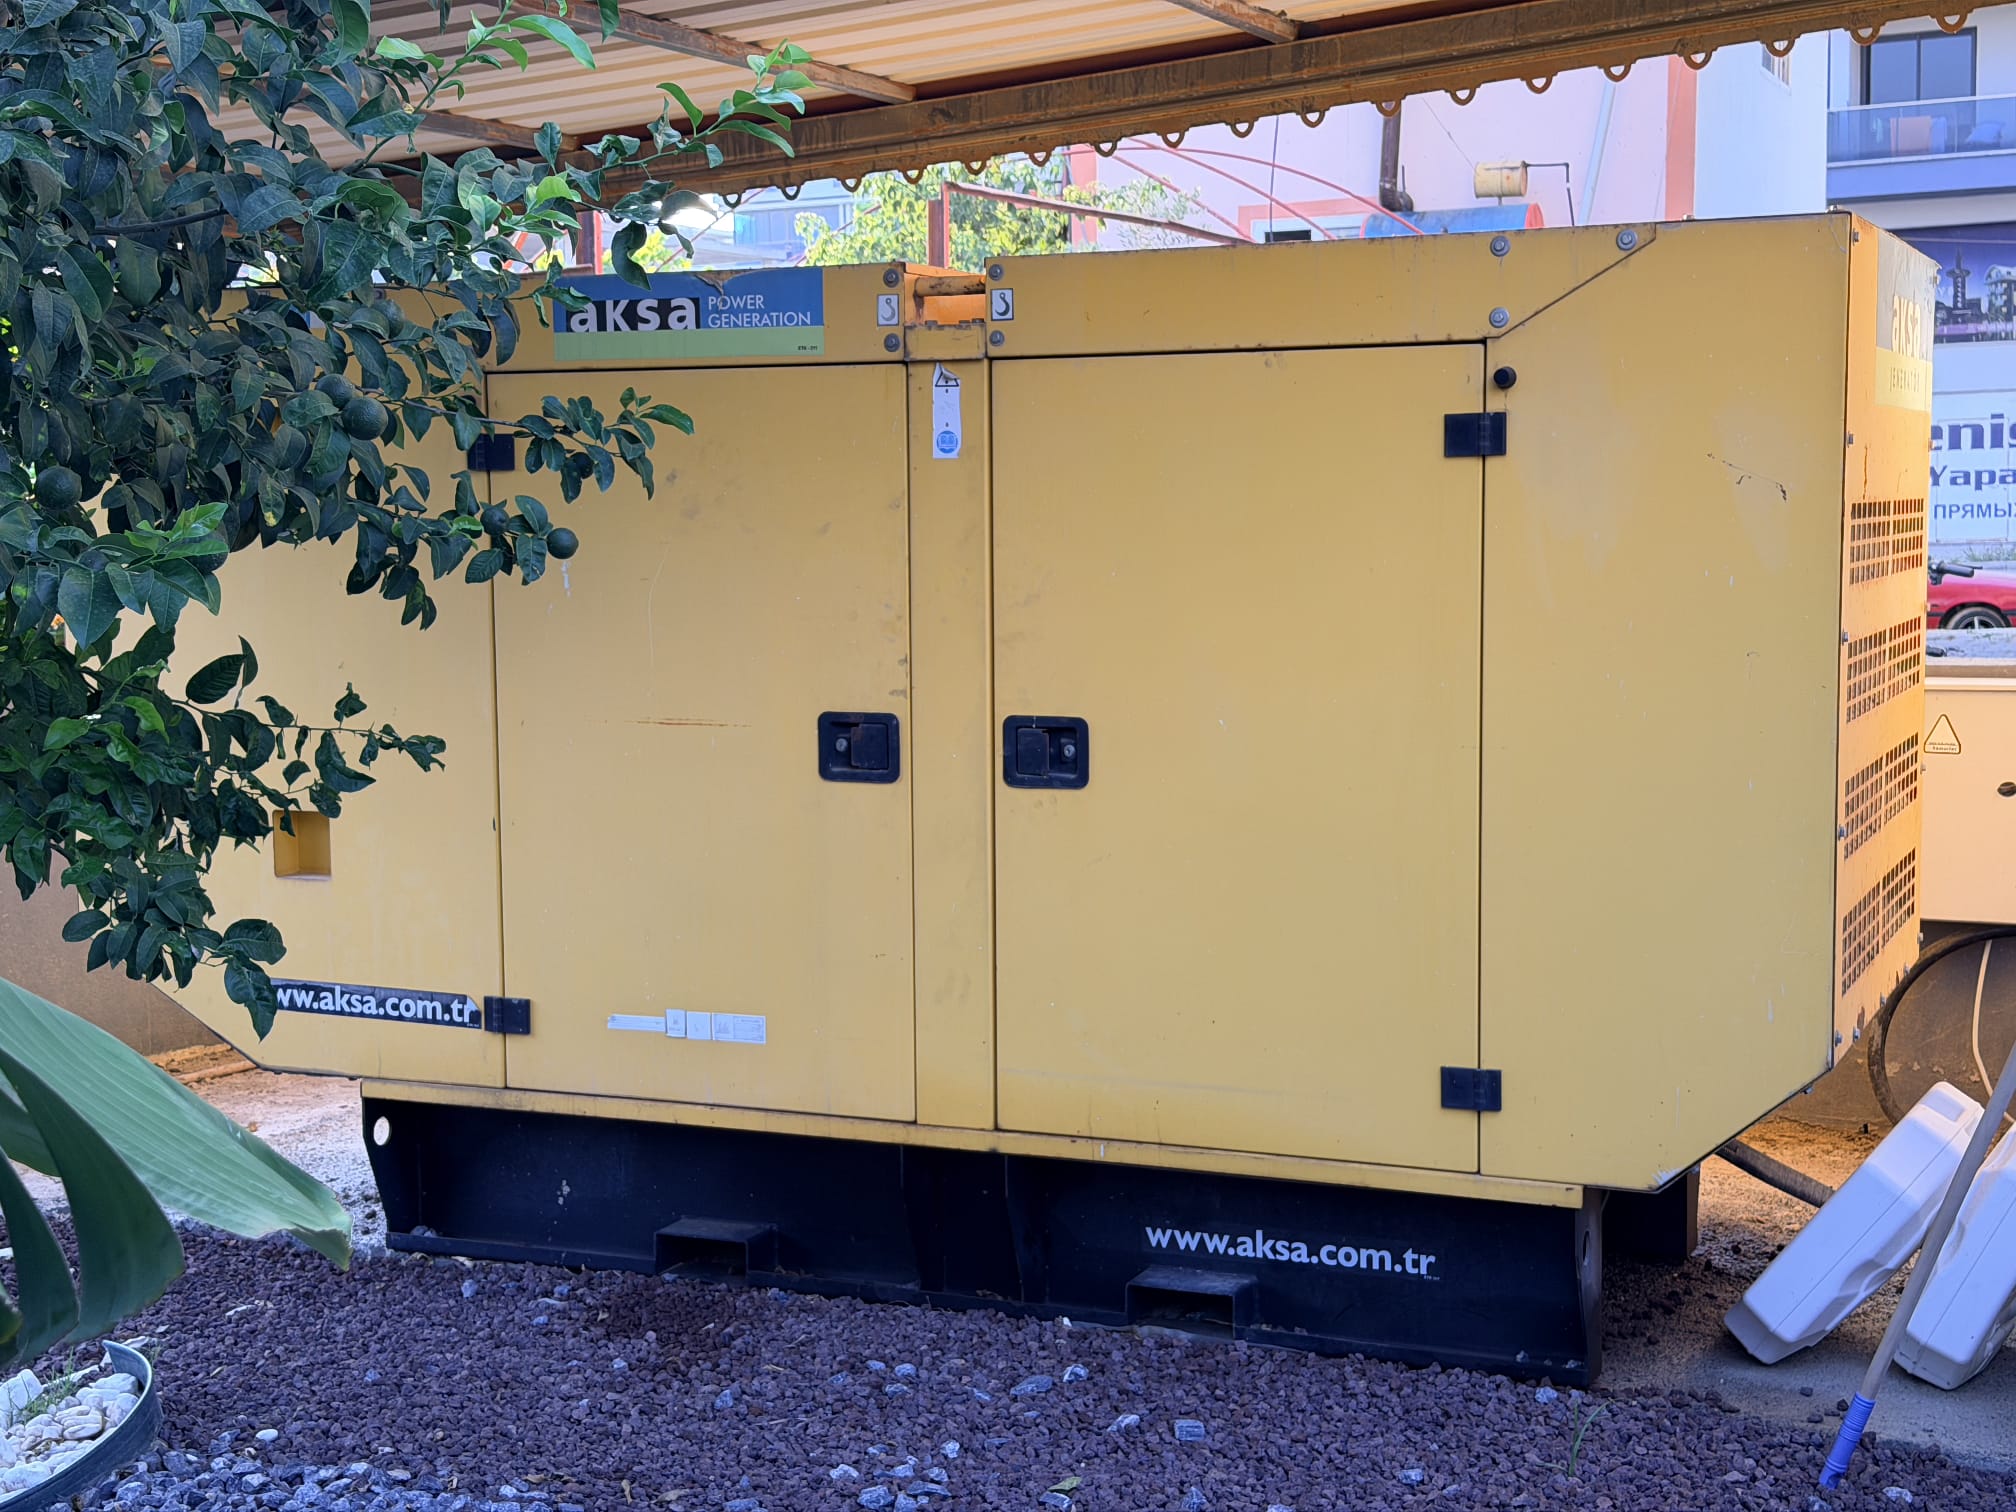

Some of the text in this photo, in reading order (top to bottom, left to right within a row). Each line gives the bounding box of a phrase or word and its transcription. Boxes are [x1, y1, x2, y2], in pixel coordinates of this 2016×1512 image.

[570, 297, 697, 332] aksa
[708, 295, 765, 310] POWER
[708, 312, 811, 328] GENERATION
[1891, 294, 1920, 359] aksa
[1931, 413, 2016, 450] ni
[1934, 502, 2016, 519] ПРЯМЫ
[277, 986, 477, 1023] ww.aksa.com.tr
[1145, 1226, 1436, 1275] www.aksa.com.tr
